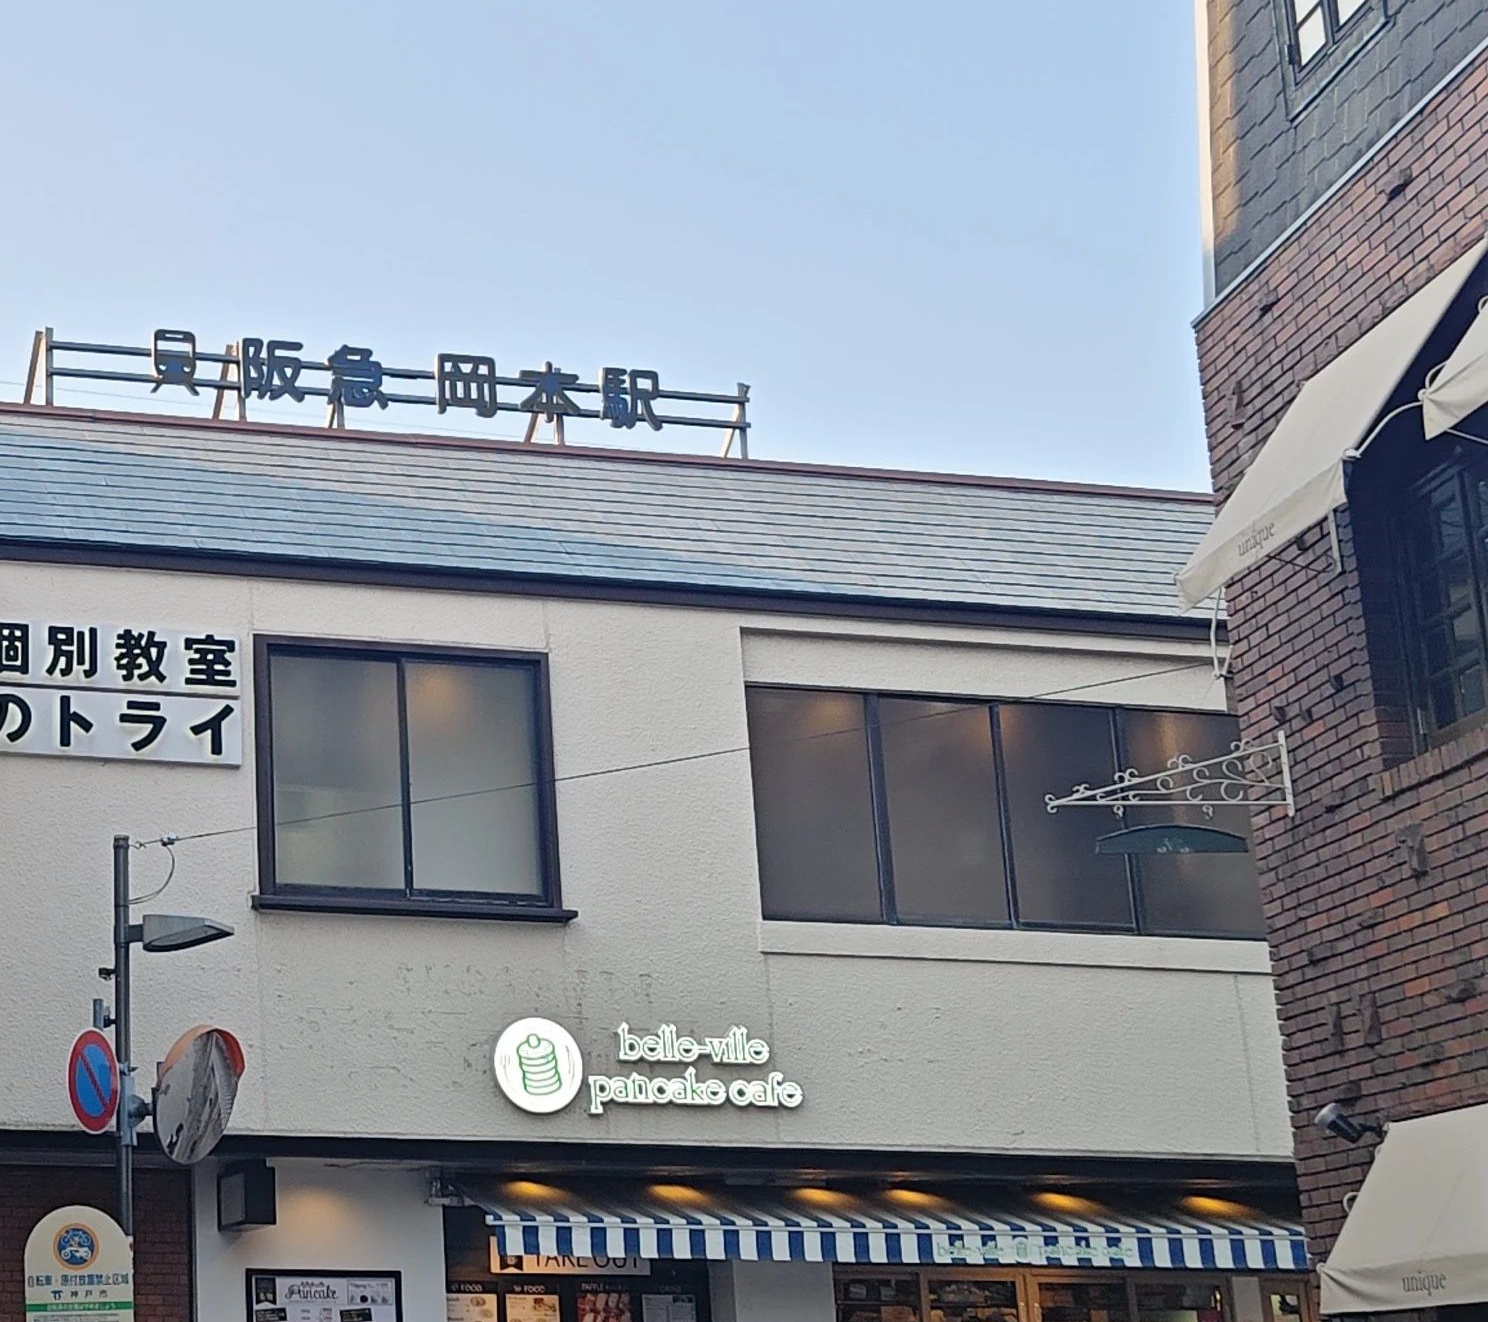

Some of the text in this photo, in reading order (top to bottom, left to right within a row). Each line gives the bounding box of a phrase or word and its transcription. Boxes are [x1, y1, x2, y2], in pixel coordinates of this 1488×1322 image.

[617, 1021, 770, 1065] belle-ville
[588, 1065, 804, 1115] pancake cafe
[1401, 1271, 1447, 1297] unique
